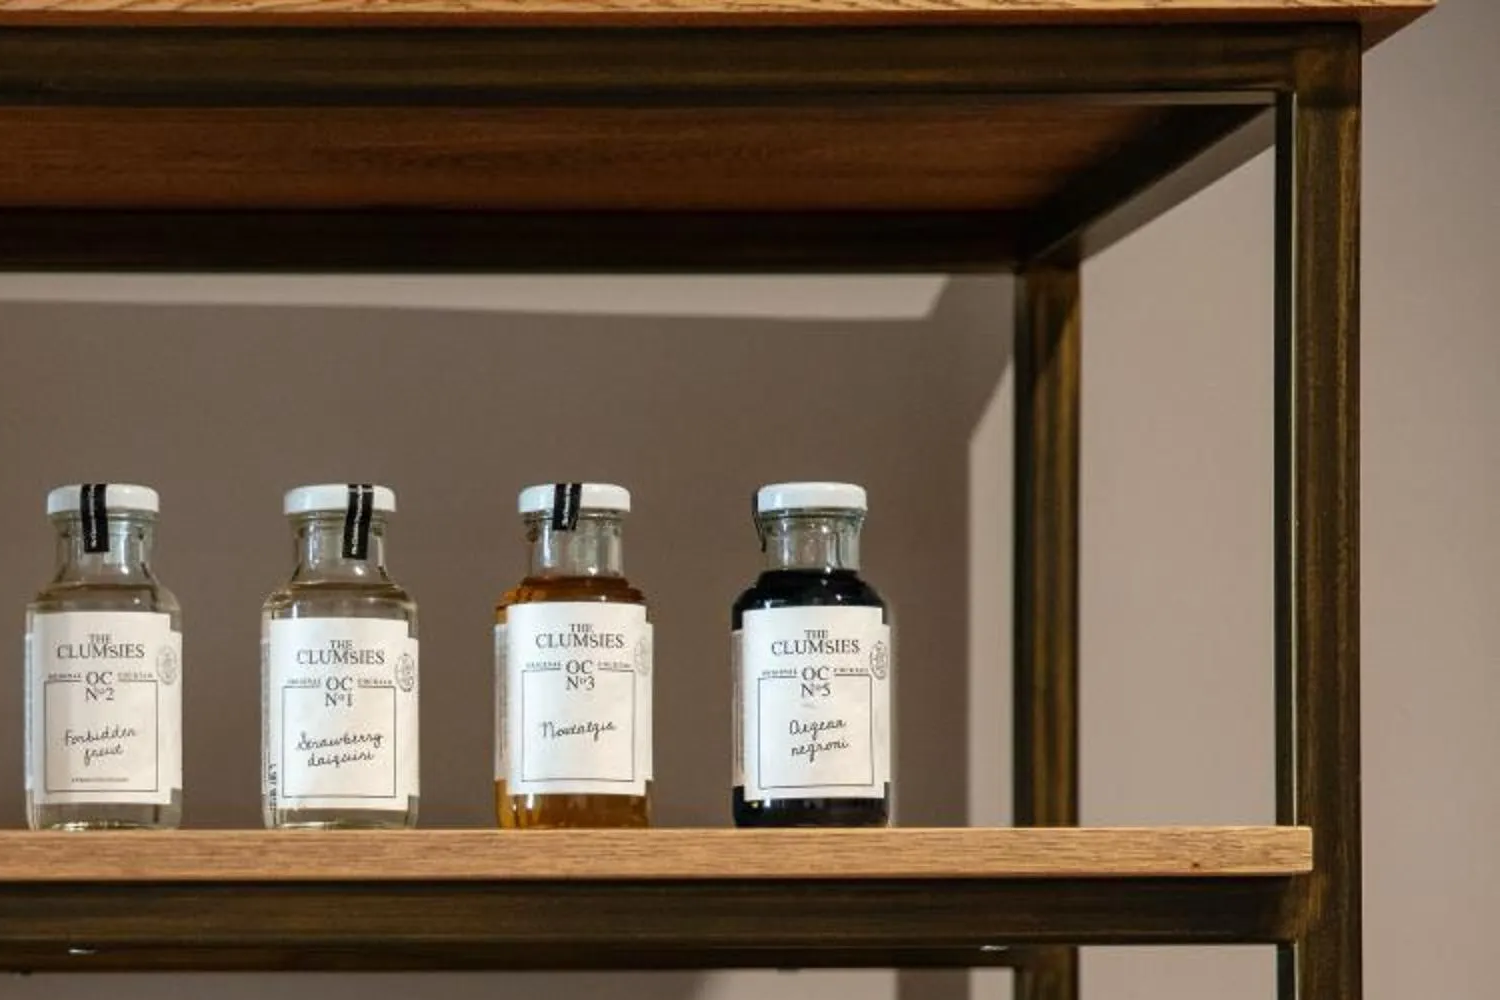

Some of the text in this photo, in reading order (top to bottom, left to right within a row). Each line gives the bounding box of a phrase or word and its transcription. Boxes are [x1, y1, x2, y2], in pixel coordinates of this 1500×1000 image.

[569, 623, 594, 633] THE
[804, 629, 829, 639] THE
[88, 633, 113, 644] THE
[329, 639, 353, 649] THE
[535, 633, 624, 649] CLUMSIES
[57, 643, 146, 660] CLUMSIES
[771, 639, 861, 655] CLUMSIES
[296, 649, 385, 665] CLUMSIES
[565, 660, 594, 675] OC
[801, 665, 830, 681] OC
[85, 671, 113, 686] OC
[325, 675, 354, 691] OC
[63, 723, 136, 746] Forbidden
[791, 739, 849, 763] negroni
